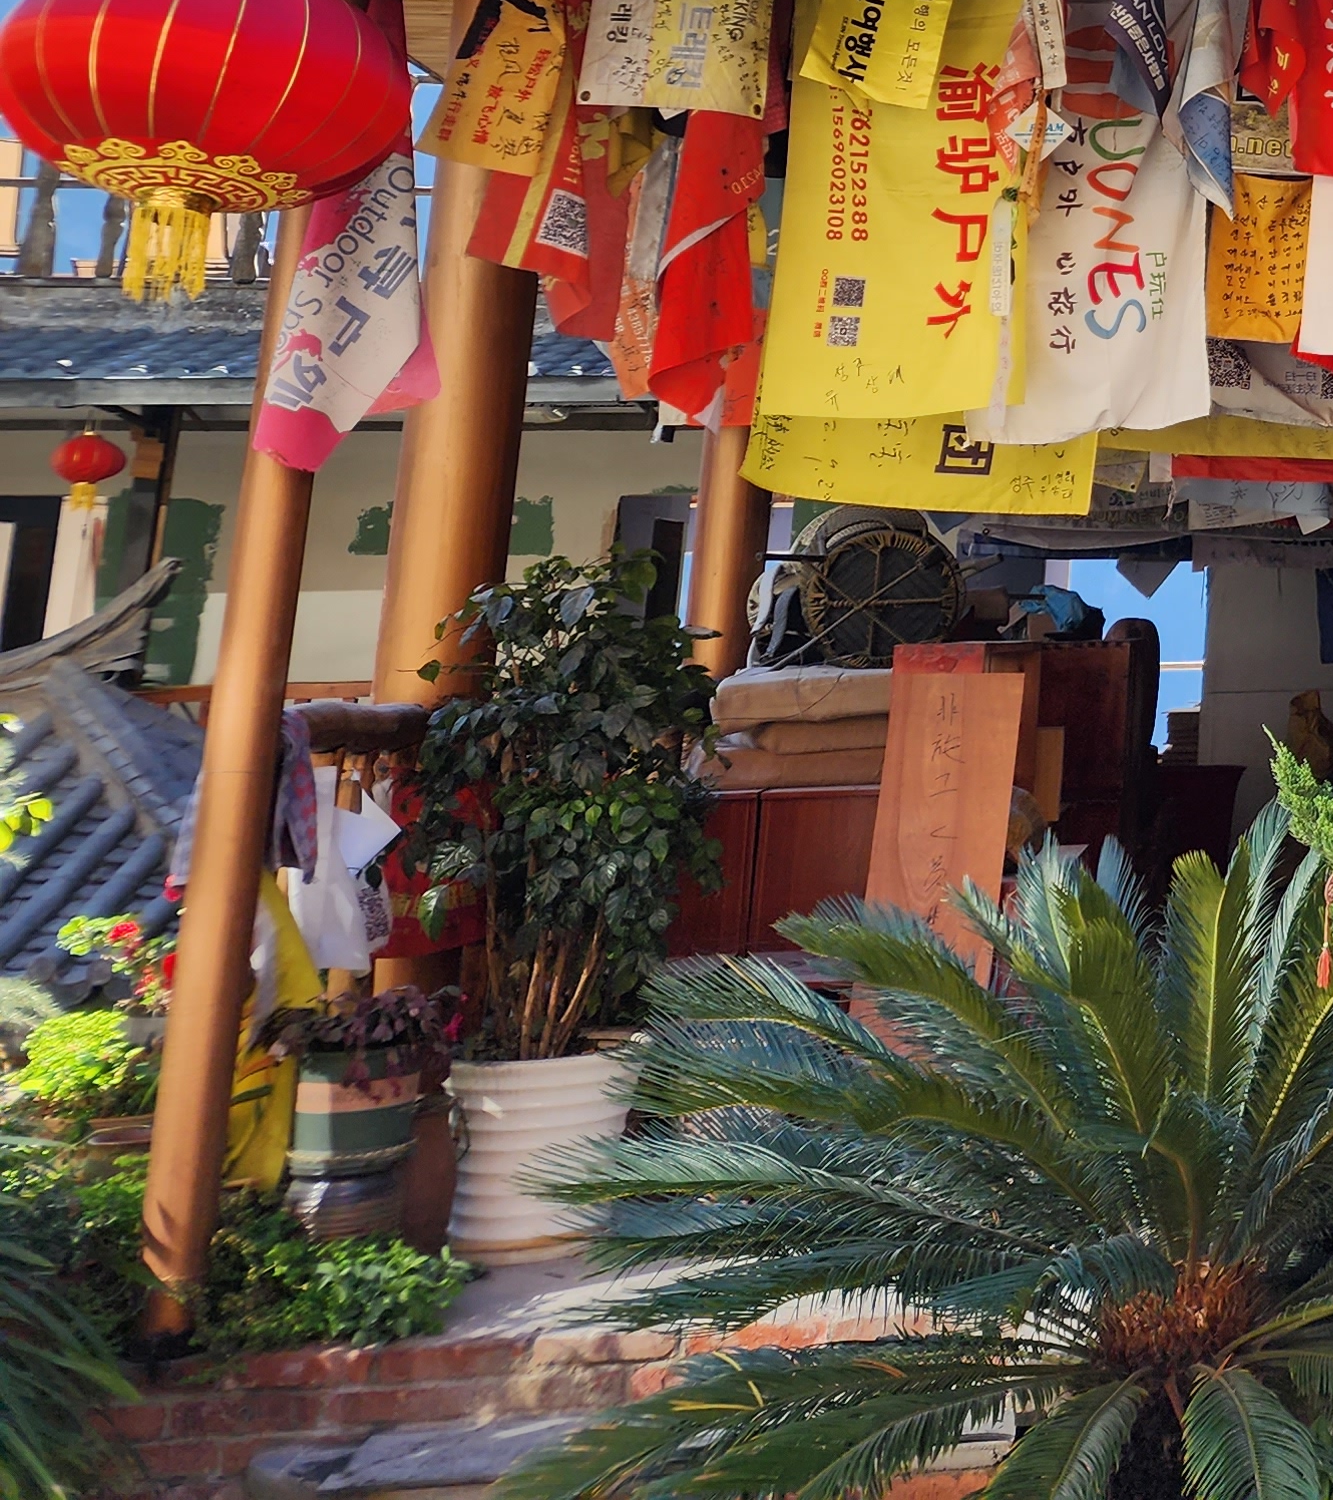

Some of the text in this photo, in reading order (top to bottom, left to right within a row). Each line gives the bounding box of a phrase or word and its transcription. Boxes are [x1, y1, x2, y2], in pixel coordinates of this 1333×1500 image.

[1111, 0, 1167, 92] 산이좋은사람들
[1136, 10, 1170, 71] LOV
[470, 84, 503, 145] 放飞心情
[321, 164, 416, 290] Outdoor
[926, 62, 1000, 339] 渝驴户外
[264, 207, 417, 412] 寻户外
